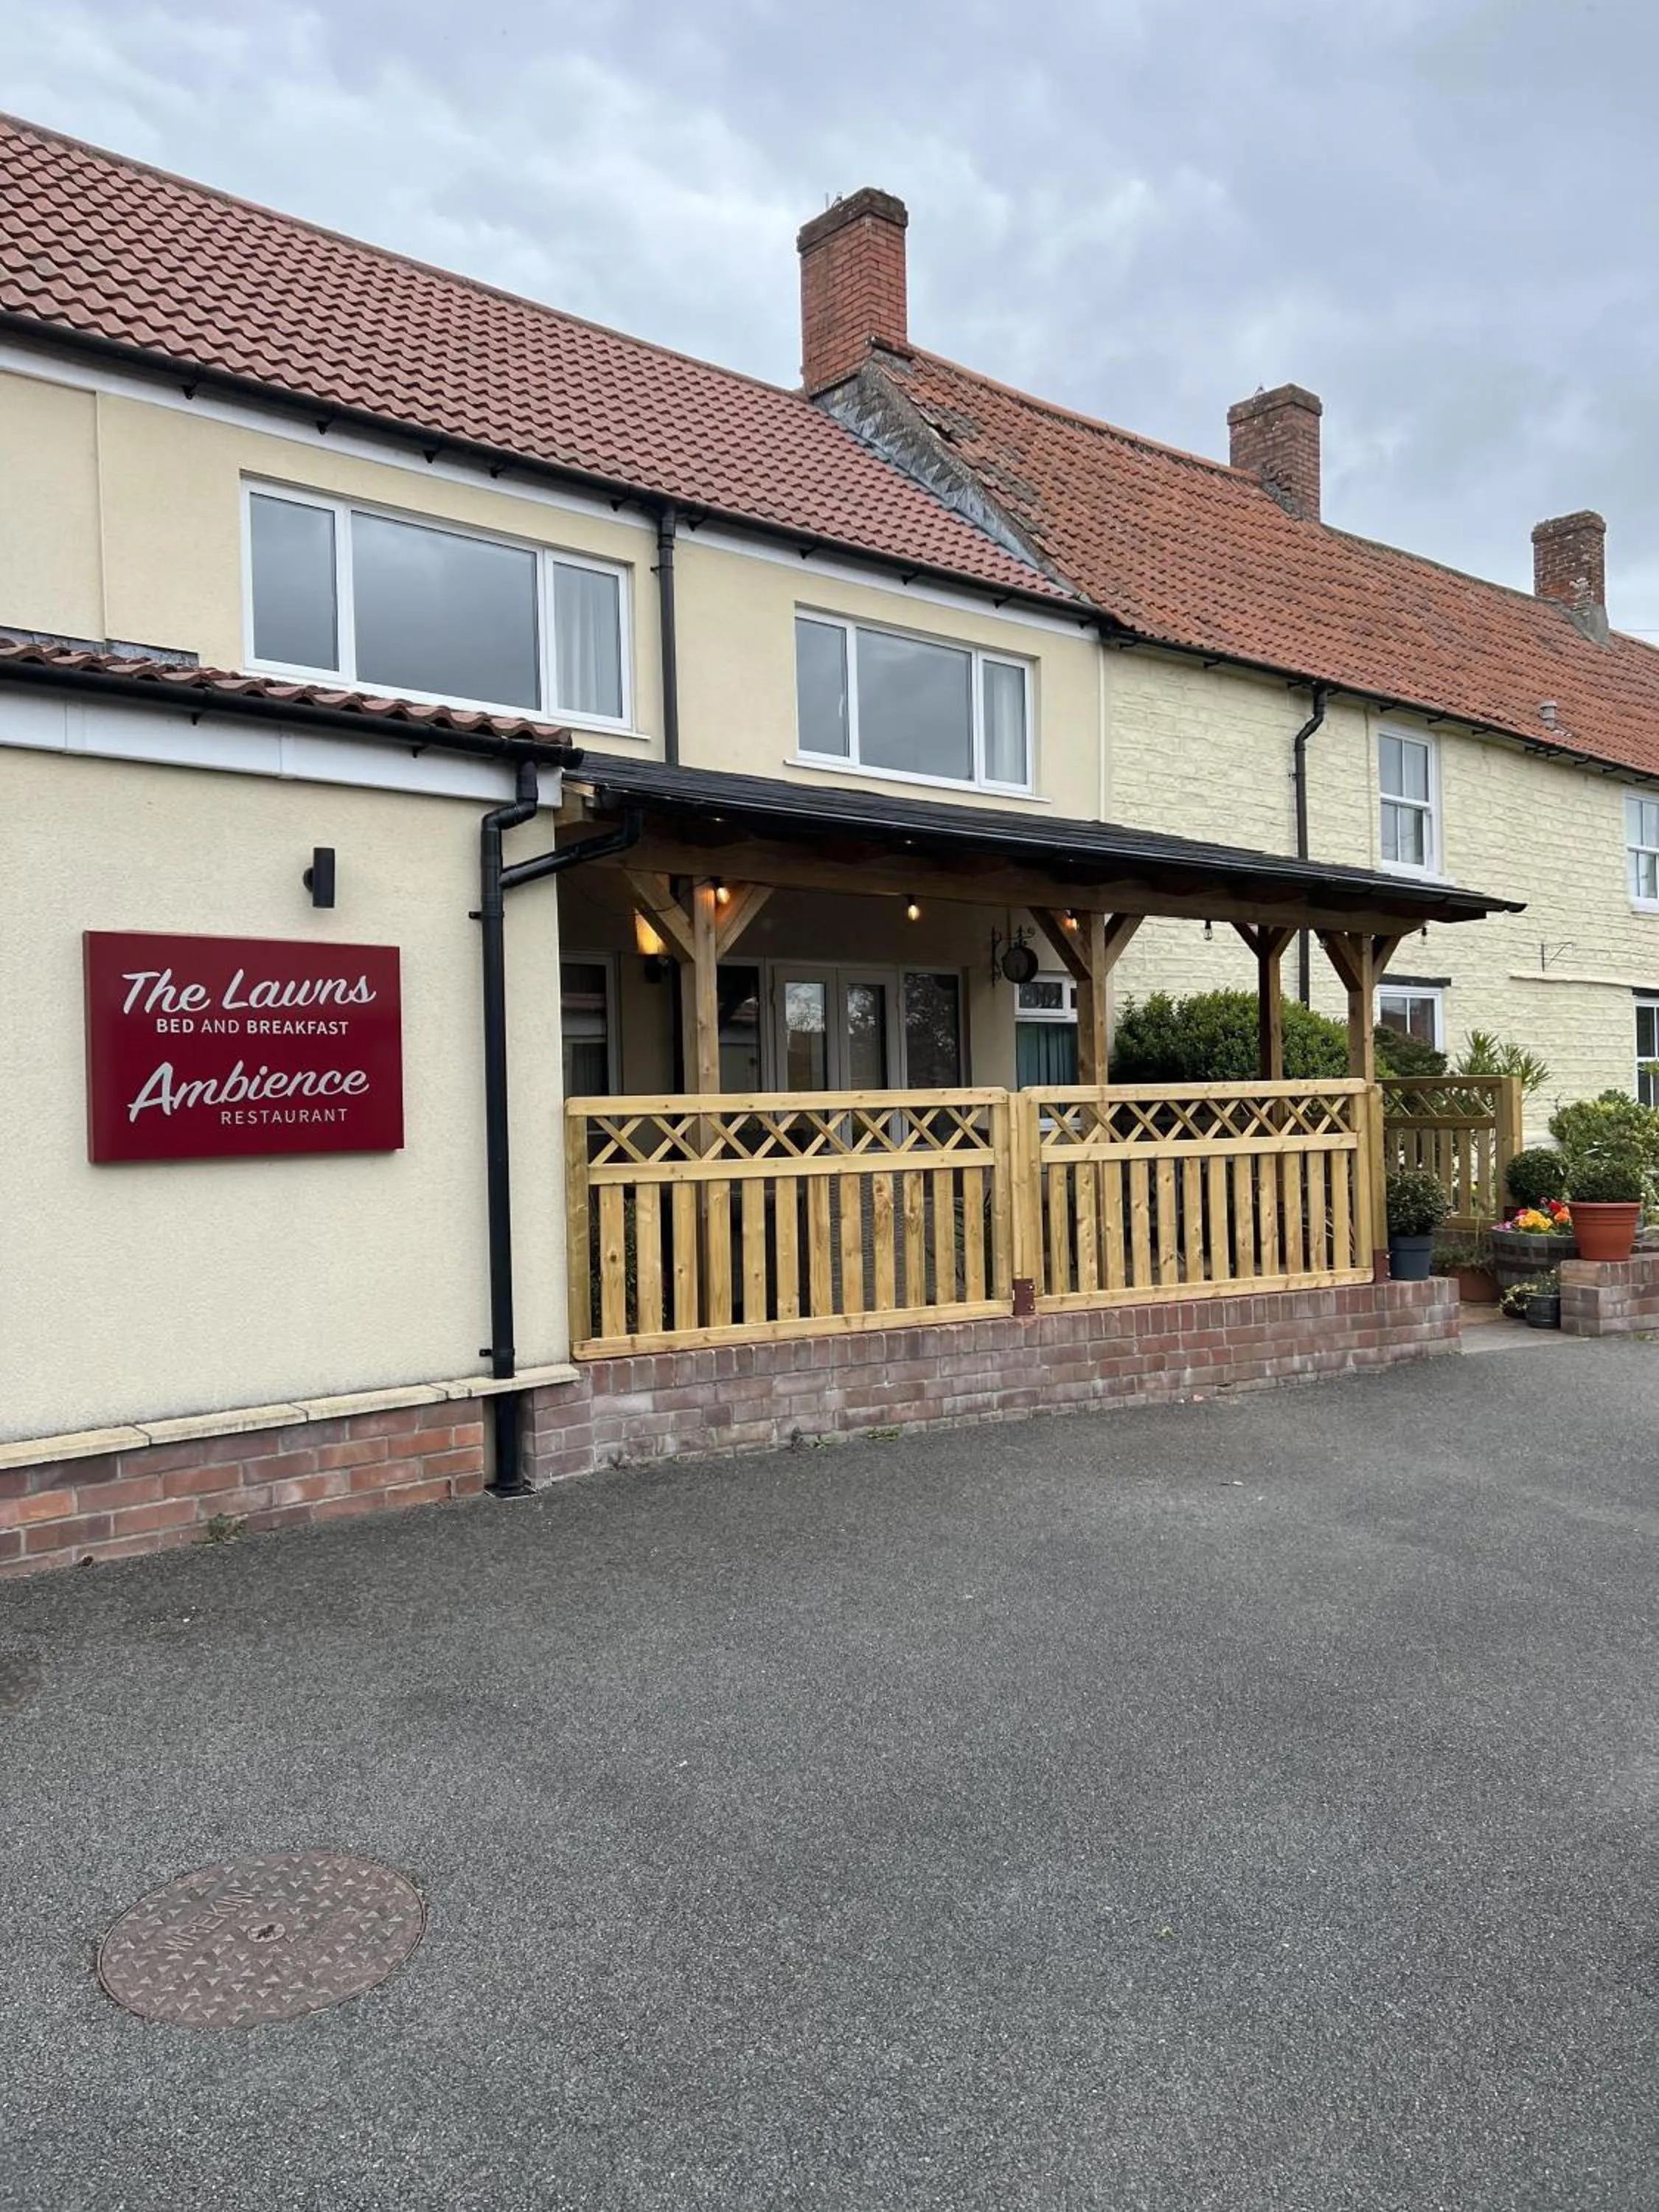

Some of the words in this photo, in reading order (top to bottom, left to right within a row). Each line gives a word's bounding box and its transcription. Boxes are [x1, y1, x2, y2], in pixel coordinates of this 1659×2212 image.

[122, 968, 211, 1015] The
[222, 968, 377, 1009] Lawns
[156, 1018, 195, 1033] BED
[201, 1019, 240, 1034] AND
[247, 1020, 349, 1035] BREAKFAST
[127, 1060, 369, 1122] Ambience
[221, 1108, 348, 1124] RESTAURANT
